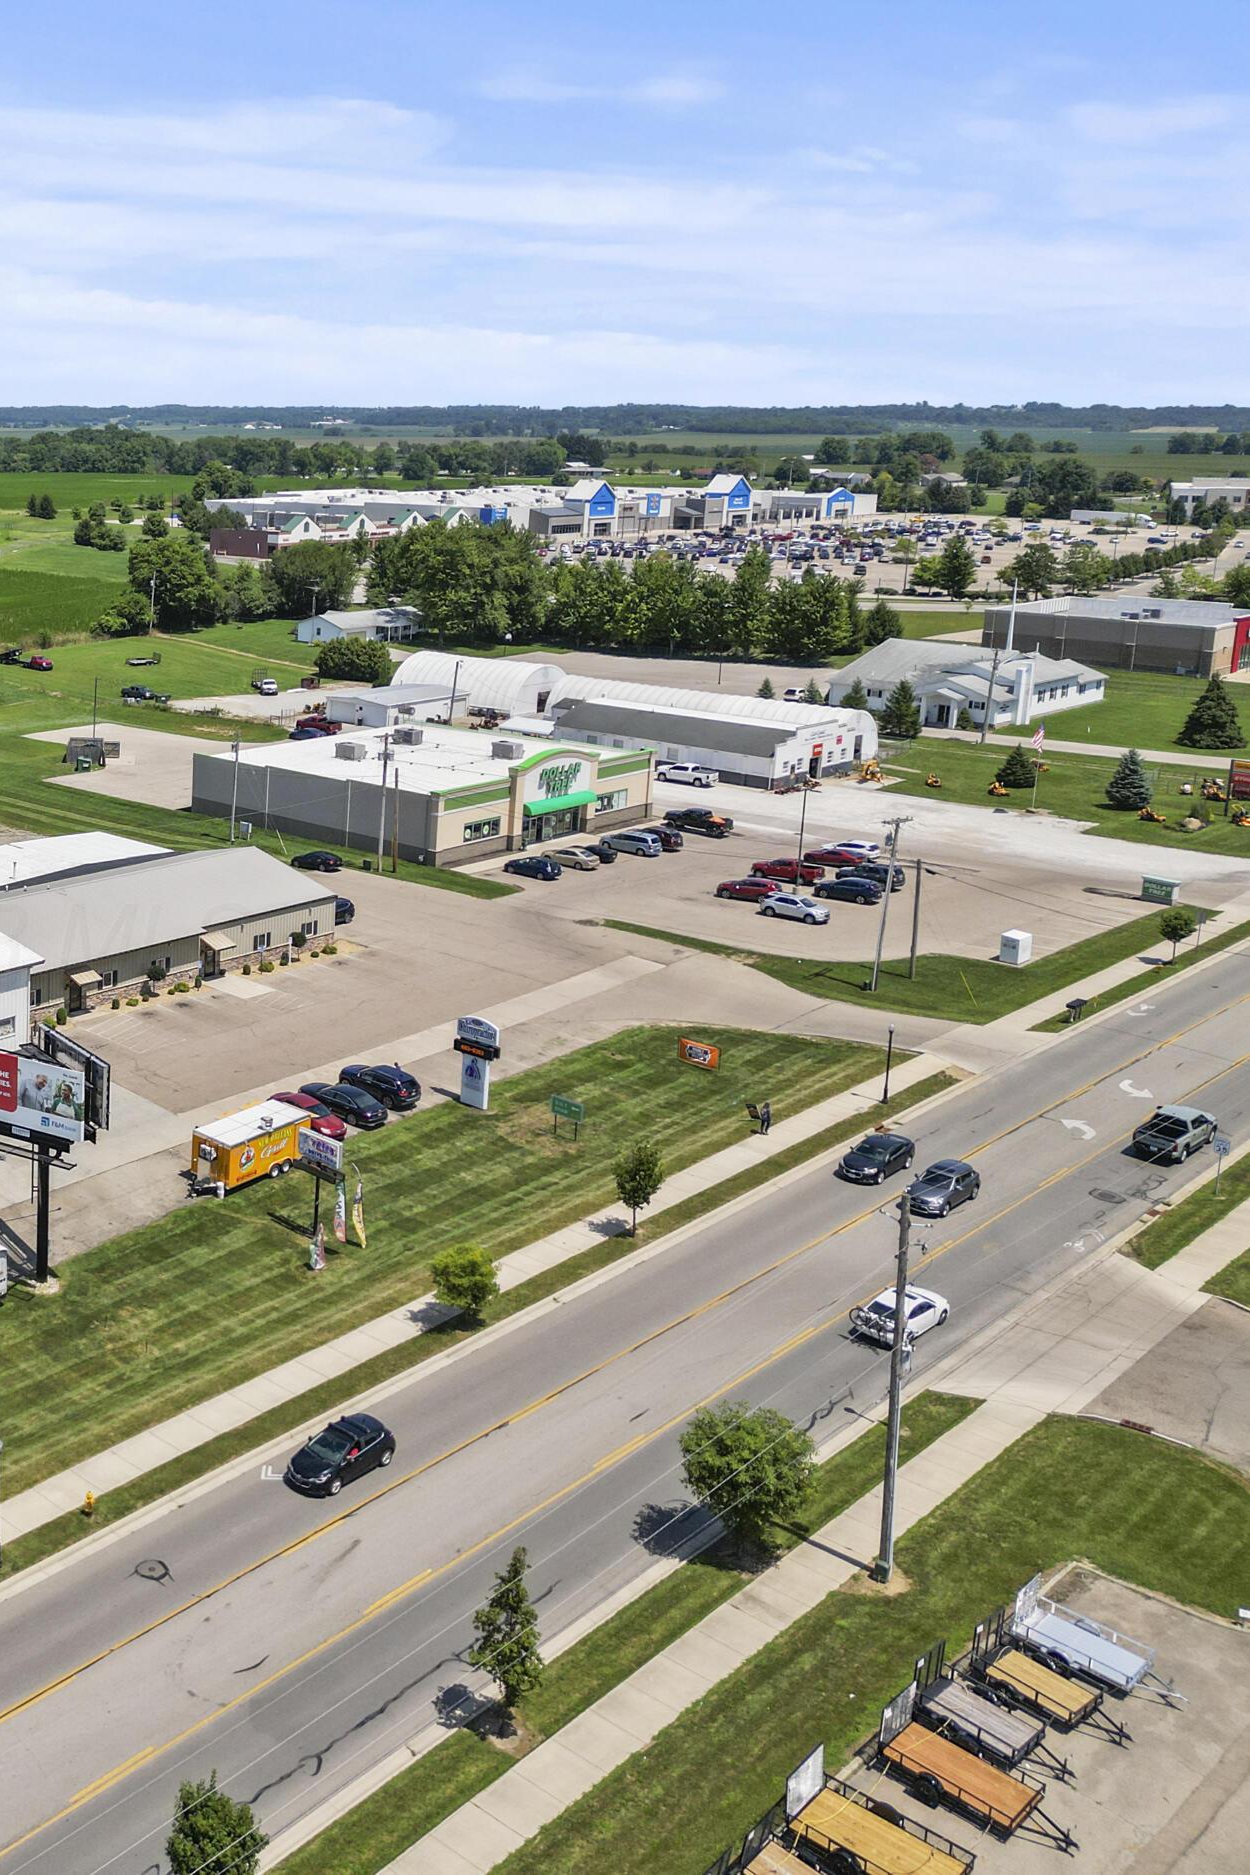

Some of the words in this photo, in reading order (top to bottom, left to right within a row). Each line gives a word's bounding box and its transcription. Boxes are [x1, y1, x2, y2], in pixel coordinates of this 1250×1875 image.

[541, 762, 581, 780] DOLLAR
[550, 777, 574, 792] TREE
[1144, 882, 1172, 892] DOLLAR
[1149, 888, 1166, 896] TREE
